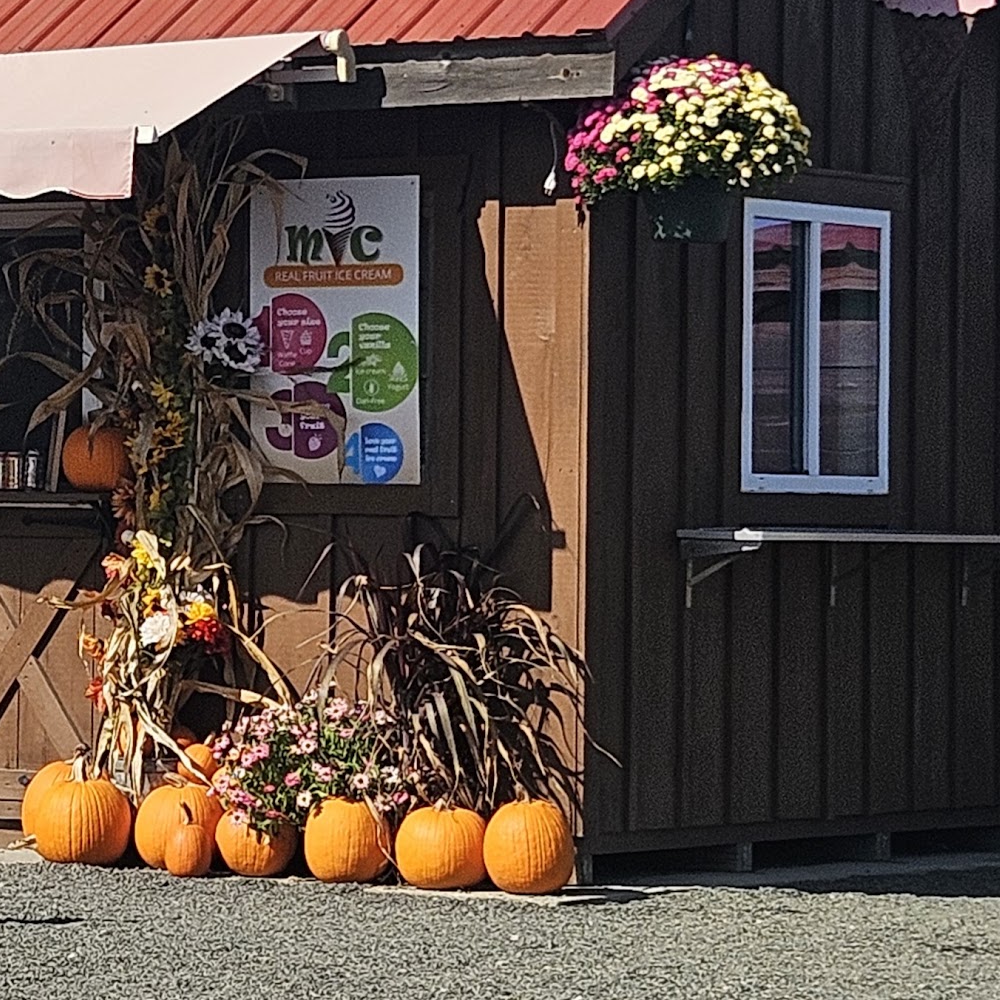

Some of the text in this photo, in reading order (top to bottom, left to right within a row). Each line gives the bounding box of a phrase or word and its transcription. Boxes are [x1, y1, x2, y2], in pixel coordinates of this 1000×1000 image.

[274, 267, 393, 283] REAL FRUIT ICE CREAM
[276, 307, 309, 317] Choose
[276, 319, 300, 328] your
[357, 322, 391, 332] Choose
[357, 332, 382, 342] your
[358, 340, 392, 350] vanilla
[299, 347, 313, 356] Cup
[278, 359, 297, 368] Cone
